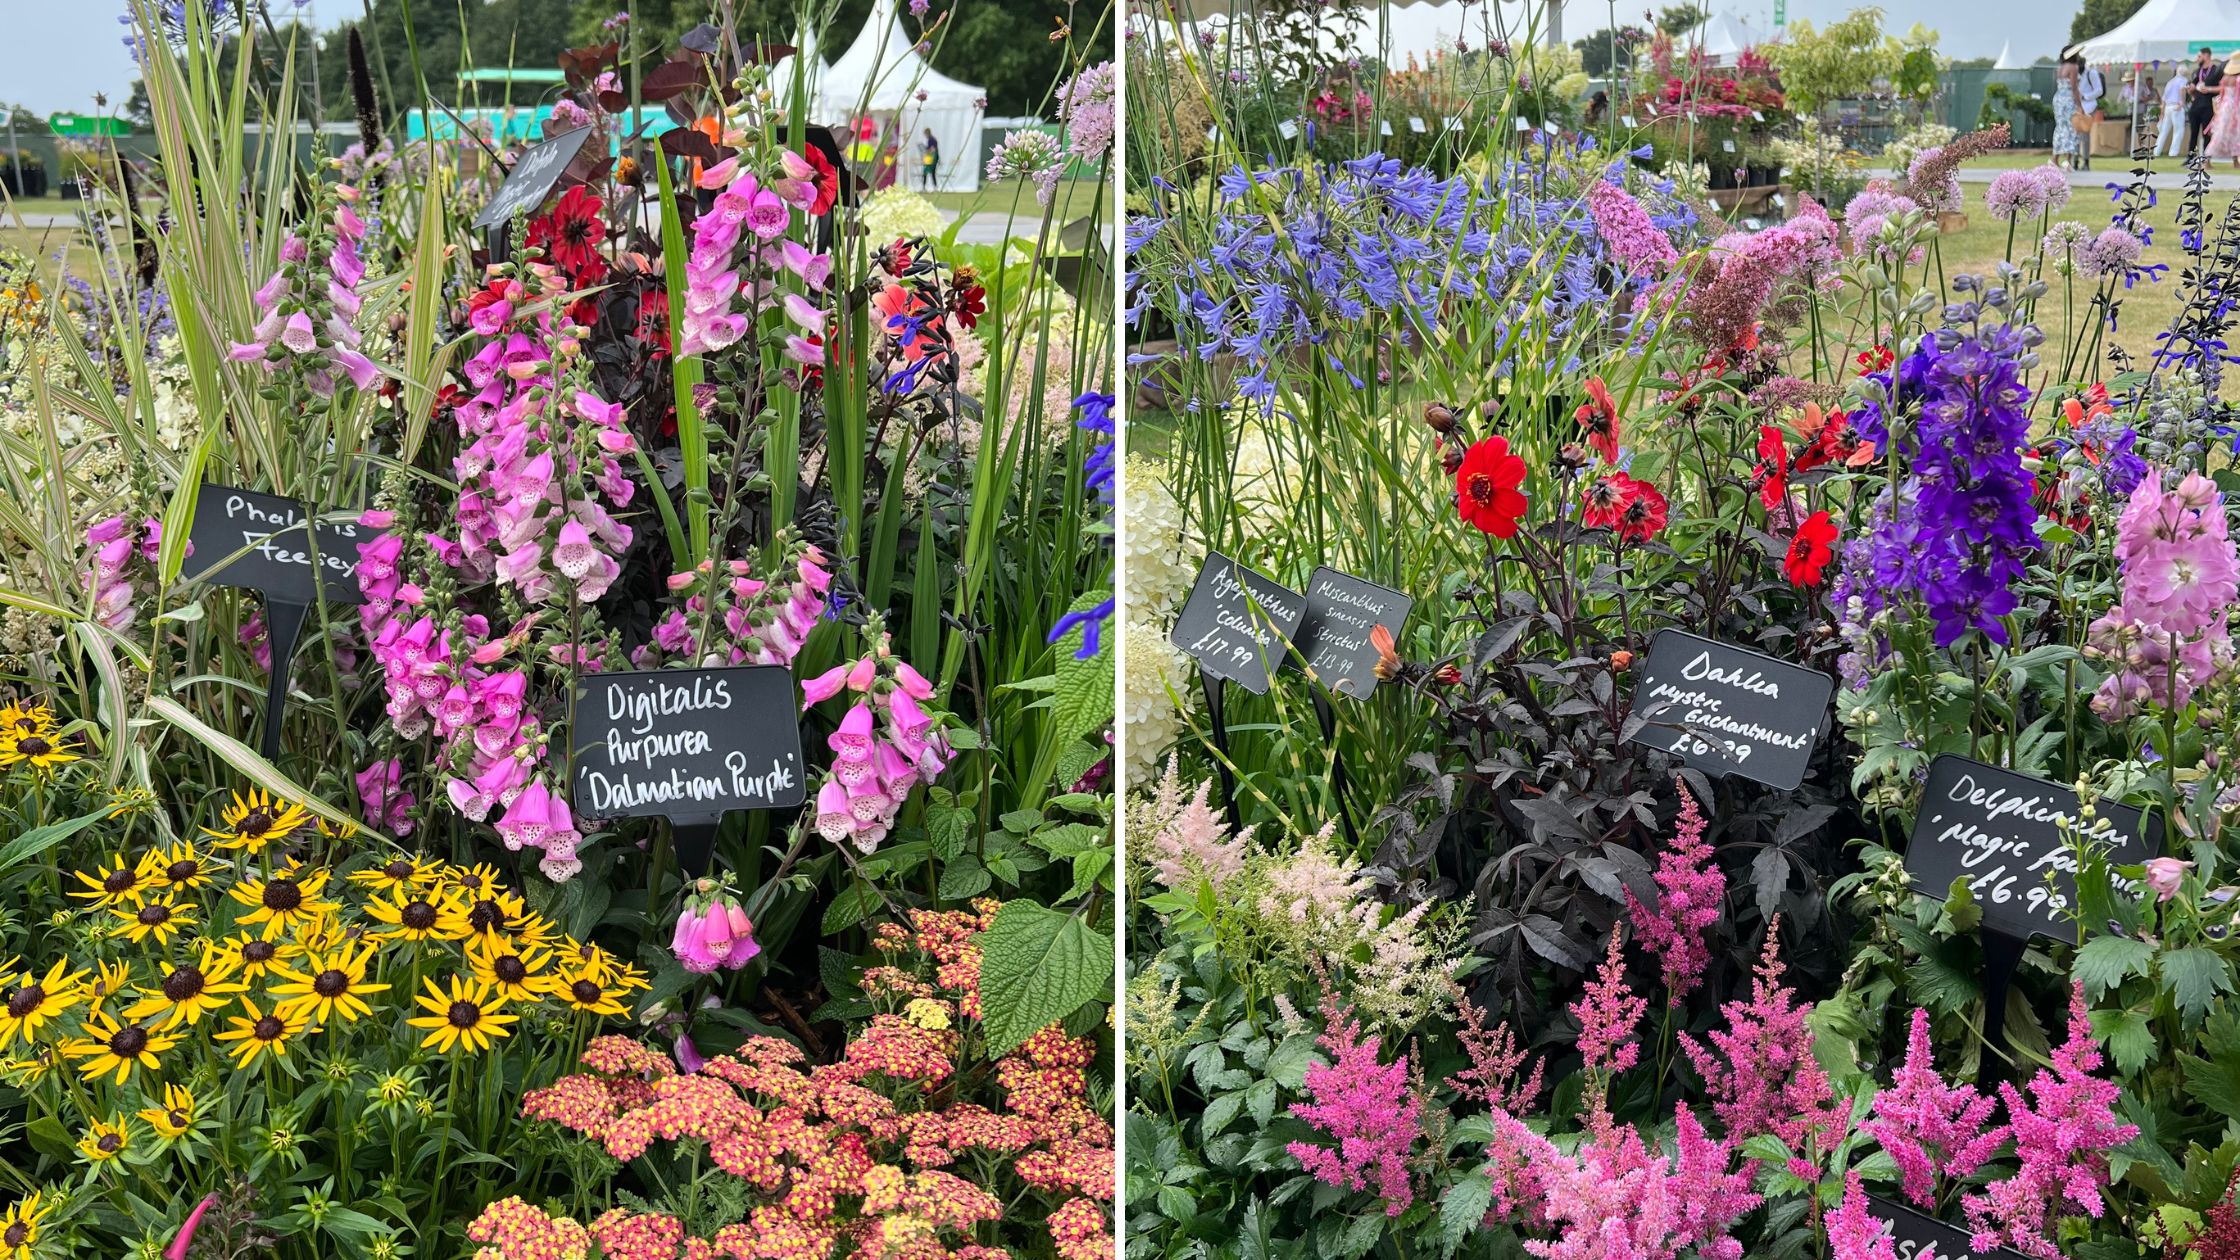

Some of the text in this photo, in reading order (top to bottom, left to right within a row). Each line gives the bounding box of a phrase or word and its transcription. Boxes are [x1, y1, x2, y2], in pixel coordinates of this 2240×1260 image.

[226, 495, 357, 538] Phalis
[1211, 565, 1296, 622] Agapanthus
[1316, 580, 1384, 616] Miscanthus
[1190, 626, 1253, 668] £17.99
[1309, 646, 1354, 675] £13.99
[1645, 676, 1722, 716] 'Mystic
[1680, 650, 1779, 699] Dahlia
[607, 674, 732, 734] Digitalis
[607, 727, 712, 769] Purpurea
[1684, 707, 1816, 750] Enchantment'
[581, 750, 796, 811] 'Dalmatian Purple'
[1931, 814, 2031, 868] 'Magic
[1968, 864, 2068, 921] £6.99
